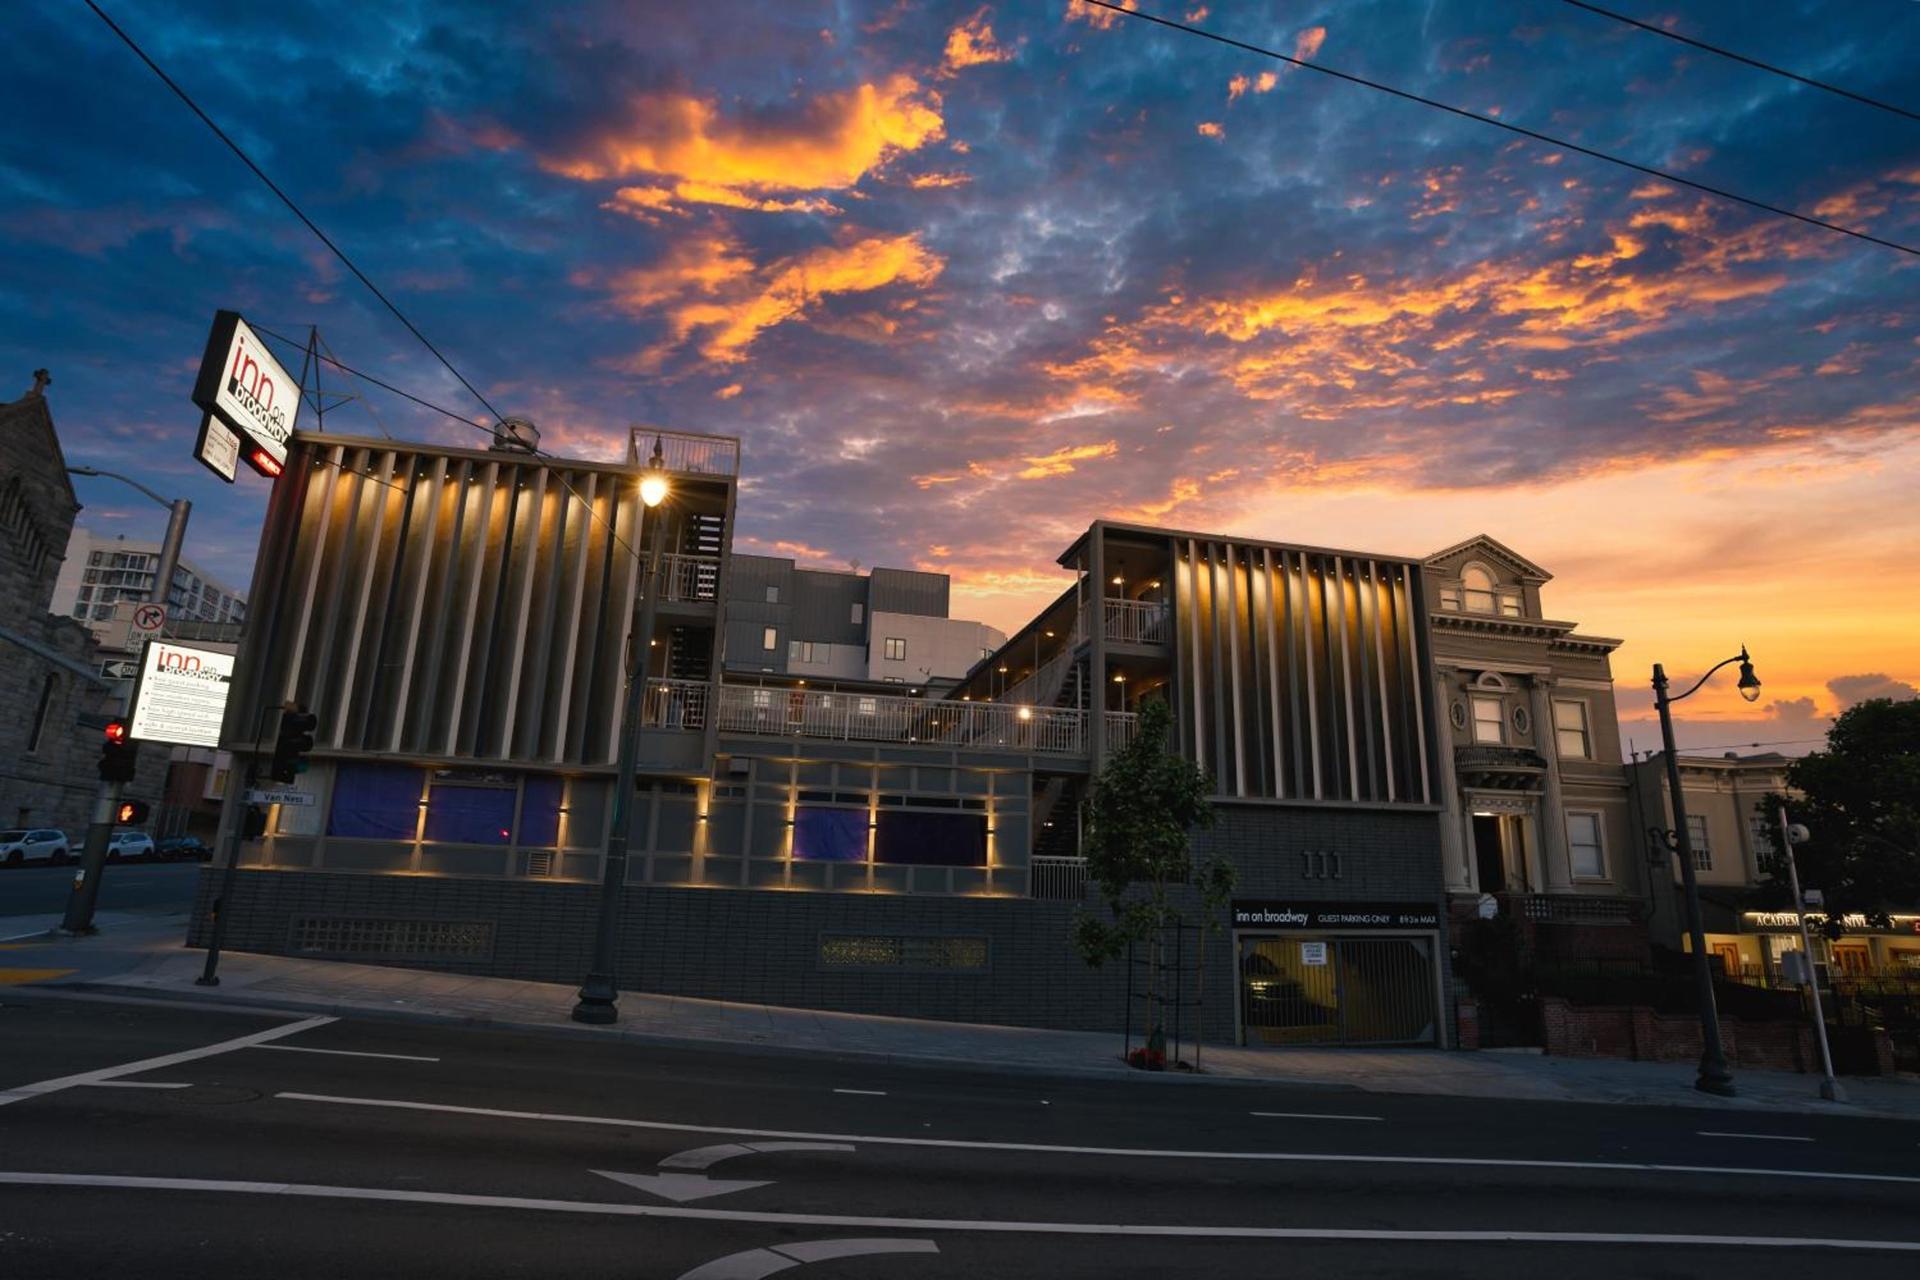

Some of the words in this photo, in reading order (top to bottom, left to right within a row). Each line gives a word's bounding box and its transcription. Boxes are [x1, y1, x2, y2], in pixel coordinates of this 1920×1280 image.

[231, 336, 275, 411] inn
[235, 384, 288, 443] broadway
[273, 406, 285, 425] on
[158, 646, 201, 671] inn
[164, 665, 222, 682] broadway
[203, 665, 217, 674] on
[264, 793, 281, 801] Van
[284, 794, 304, 803] Ness
[1236, 909, 1249, 922] inn
[1252, 913, 1263, 922] on
[1264, 908, 1309, 926] broadway
[1757, 915, 1805, 927] ACADEM
